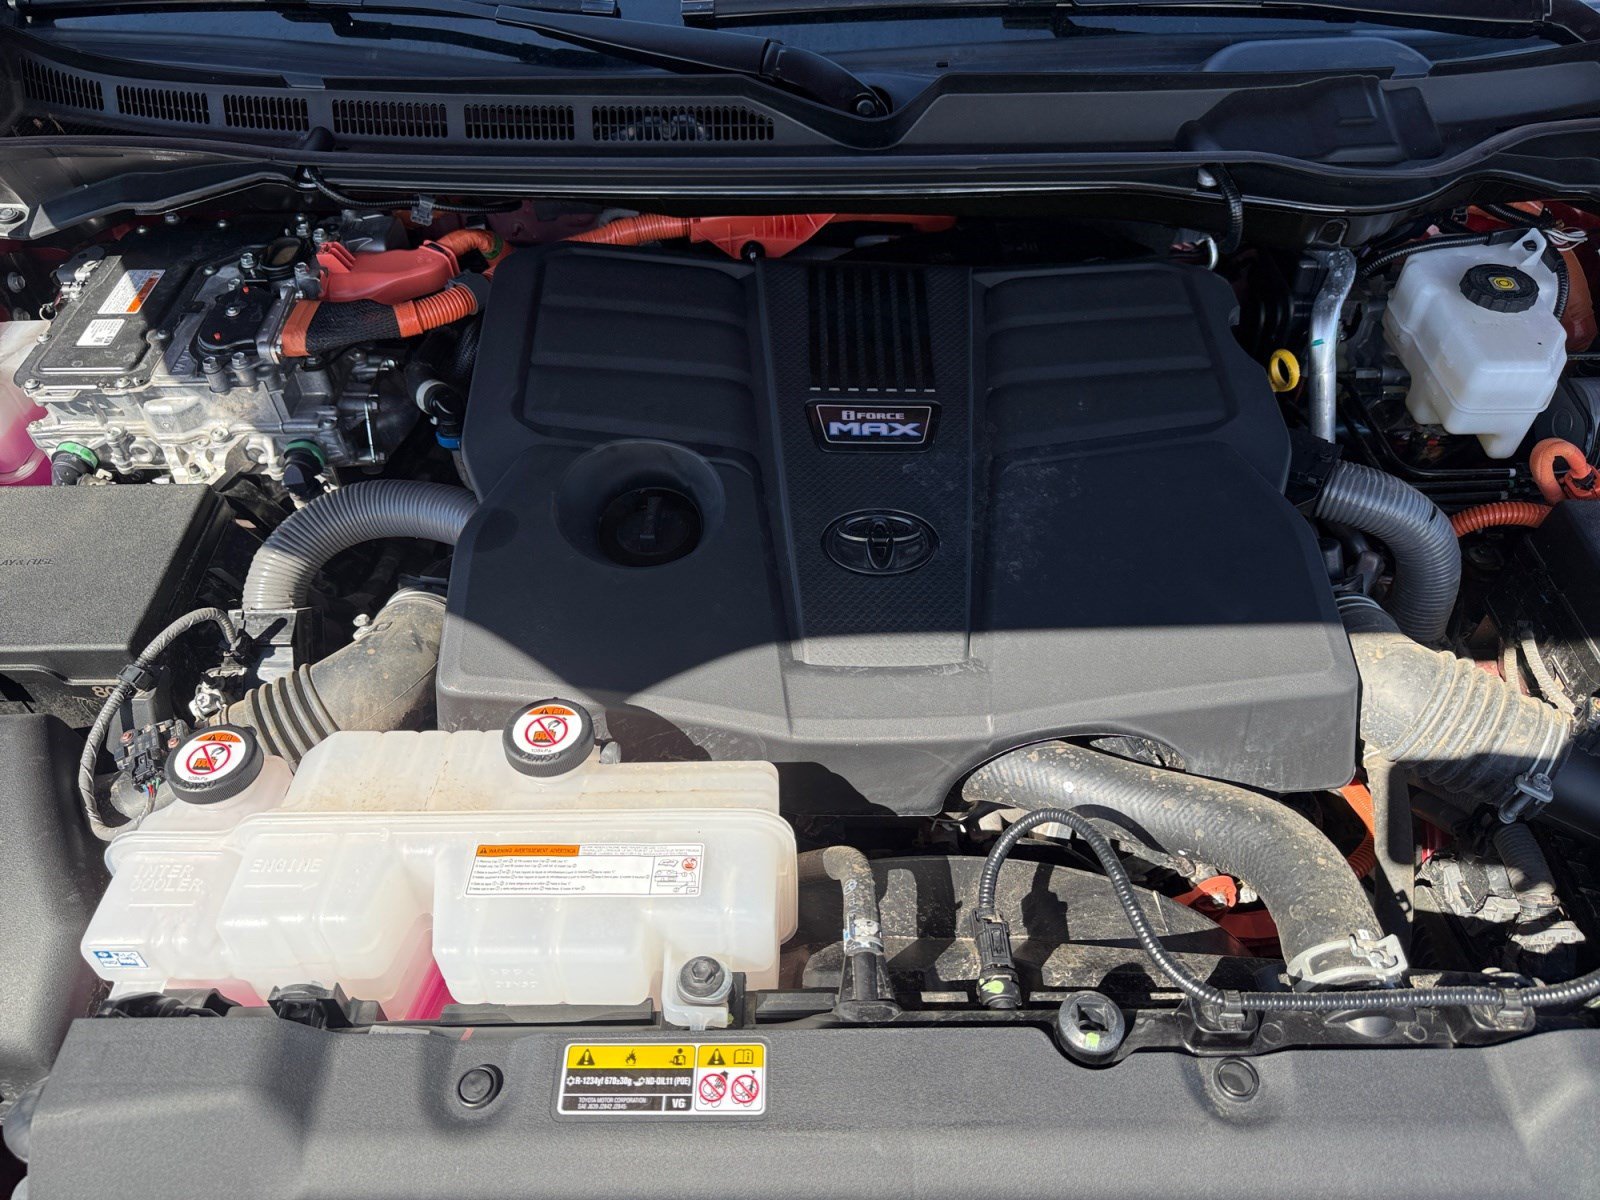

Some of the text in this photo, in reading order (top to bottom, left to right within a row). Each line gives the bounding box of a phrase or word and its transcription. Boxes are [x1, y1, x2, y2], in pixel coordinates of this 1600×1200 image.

[857, 412, 904, 420] FORCE
[829, 422, 921, 437] MAX
[133, 864, 195, 878] INTER
[249, 858, 323, 873] ENGINE
[575, 1076, 604, 1086] R-1234yf
[674, 1076, 691, 1087] (POE)
[671, 1099, 686, 1108] VG
